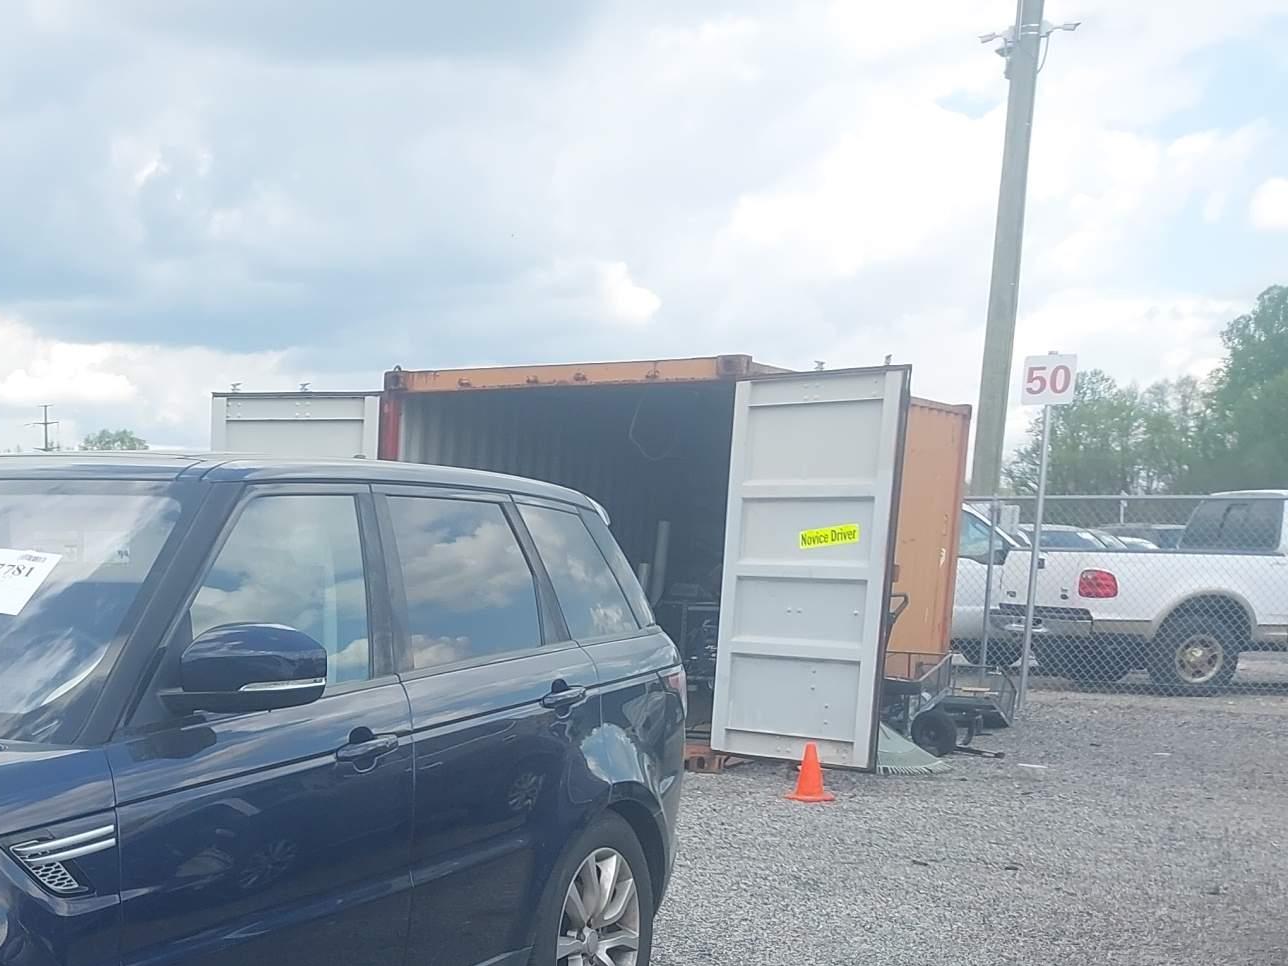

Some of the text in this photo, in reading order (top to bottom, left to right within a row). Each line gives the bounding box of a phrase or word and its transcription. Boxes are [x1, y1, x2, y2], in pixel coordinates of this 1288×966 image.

[1025, 365, 1071, 394] 50
[801, 528, 856, 546] Novice Driver
